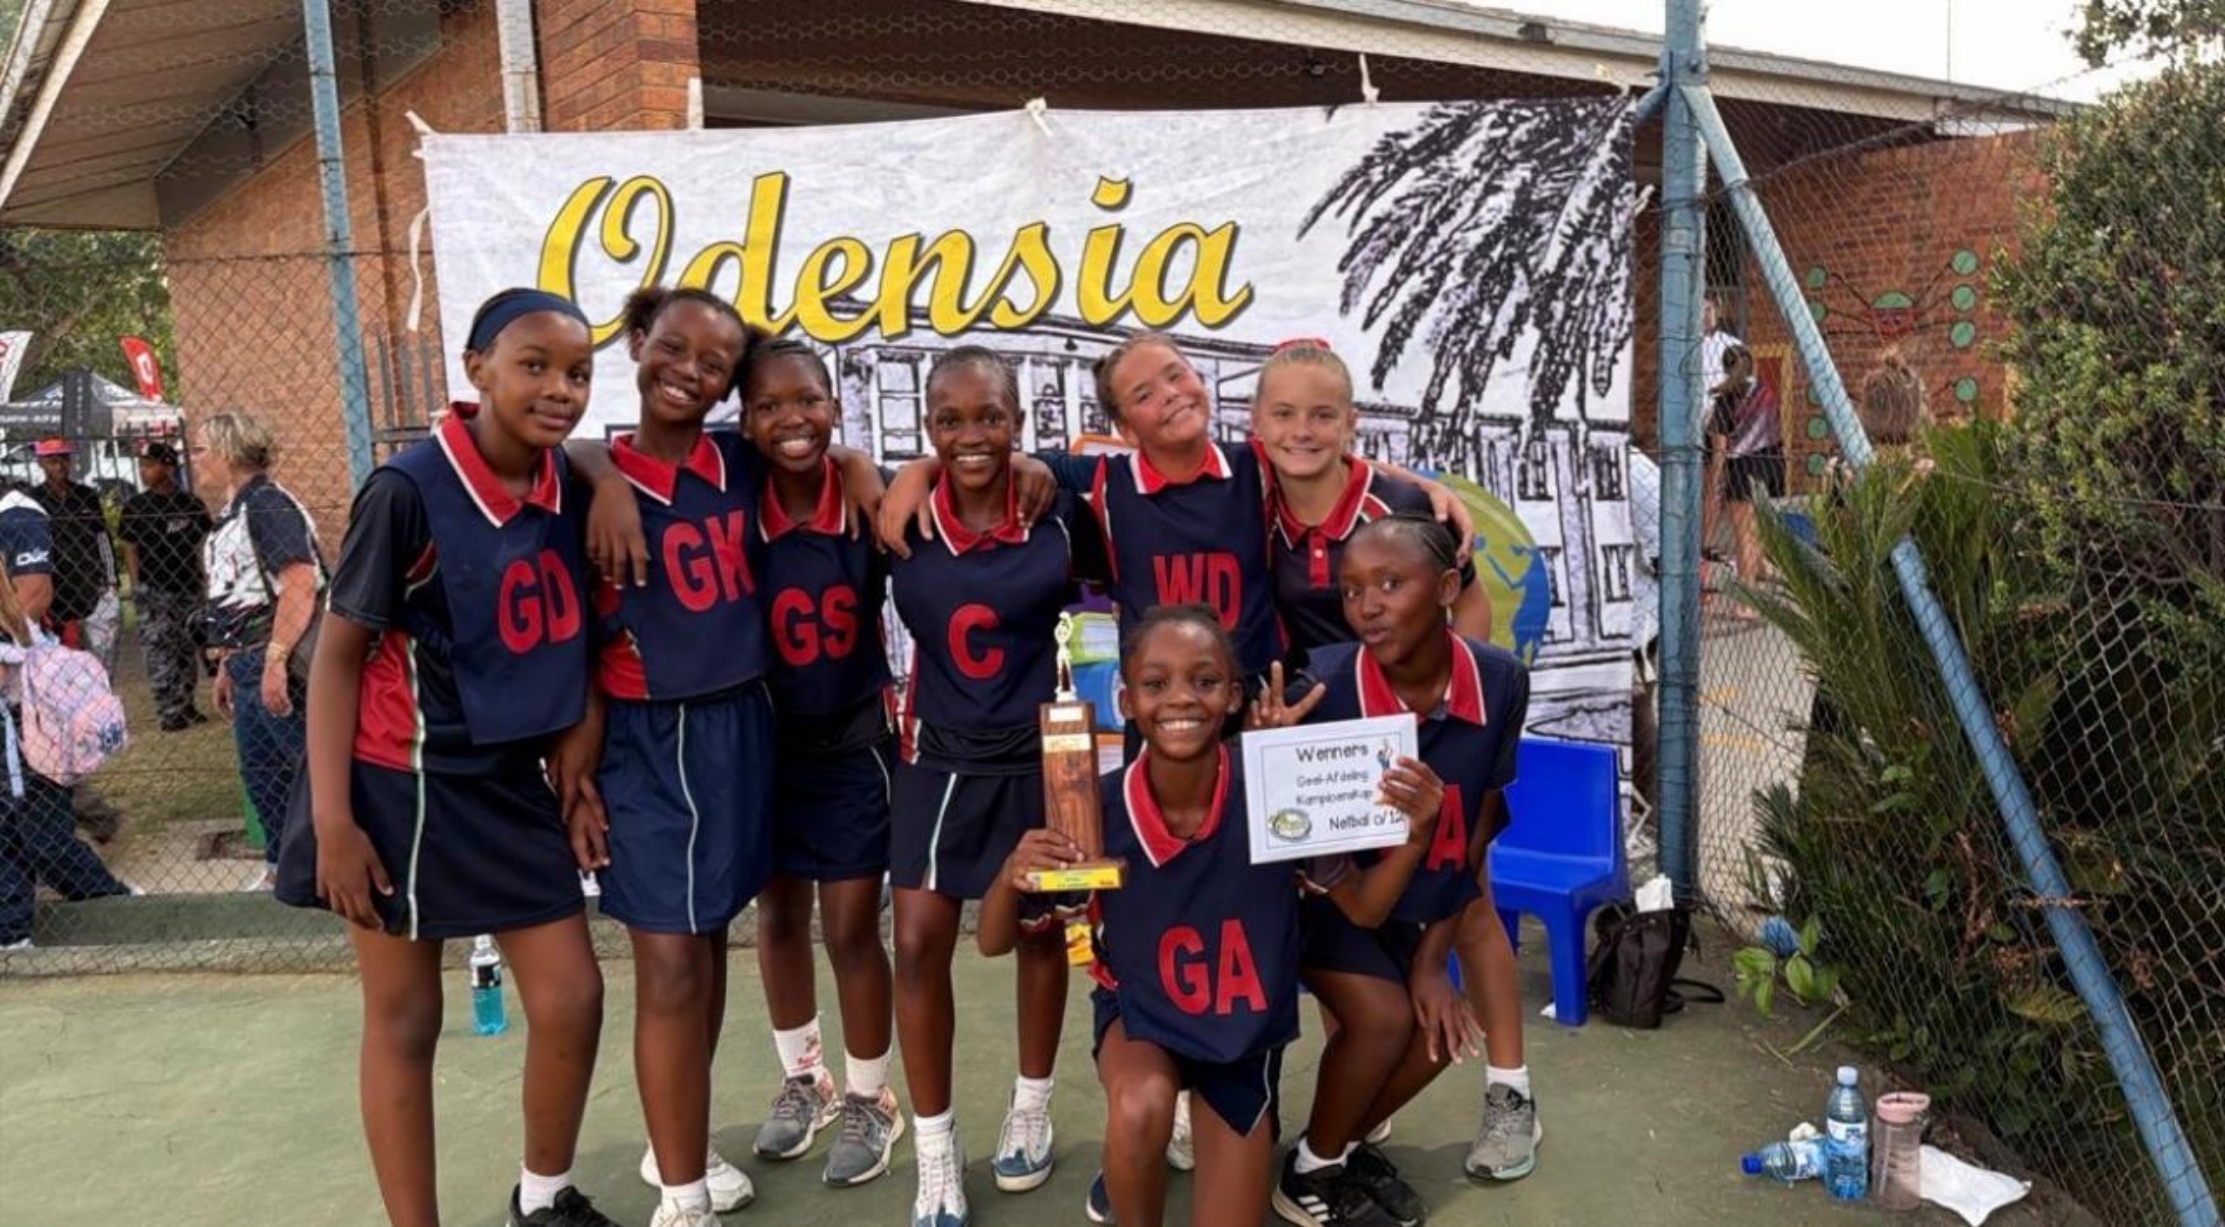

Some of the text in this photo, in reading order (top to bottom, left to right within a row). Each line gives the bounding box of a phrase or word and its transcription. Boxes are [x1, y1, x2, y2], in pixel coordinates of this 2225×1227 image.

[536, 171, 1252, 345] Odensia
[498, 549, 581, 655] GD
[661, 509, 755, 613] GK
[1153, 552, 1243, 633] WD
[771, 585, 857, 666] GS
[947, 603, 1004, 679] C
[1296, 744, 1369, 763] Wenners
[1329, 813, 1370, 831] Netbal
[1424, 784, 1467, 872] A
[1158, 918, 1269, 1016] GA
